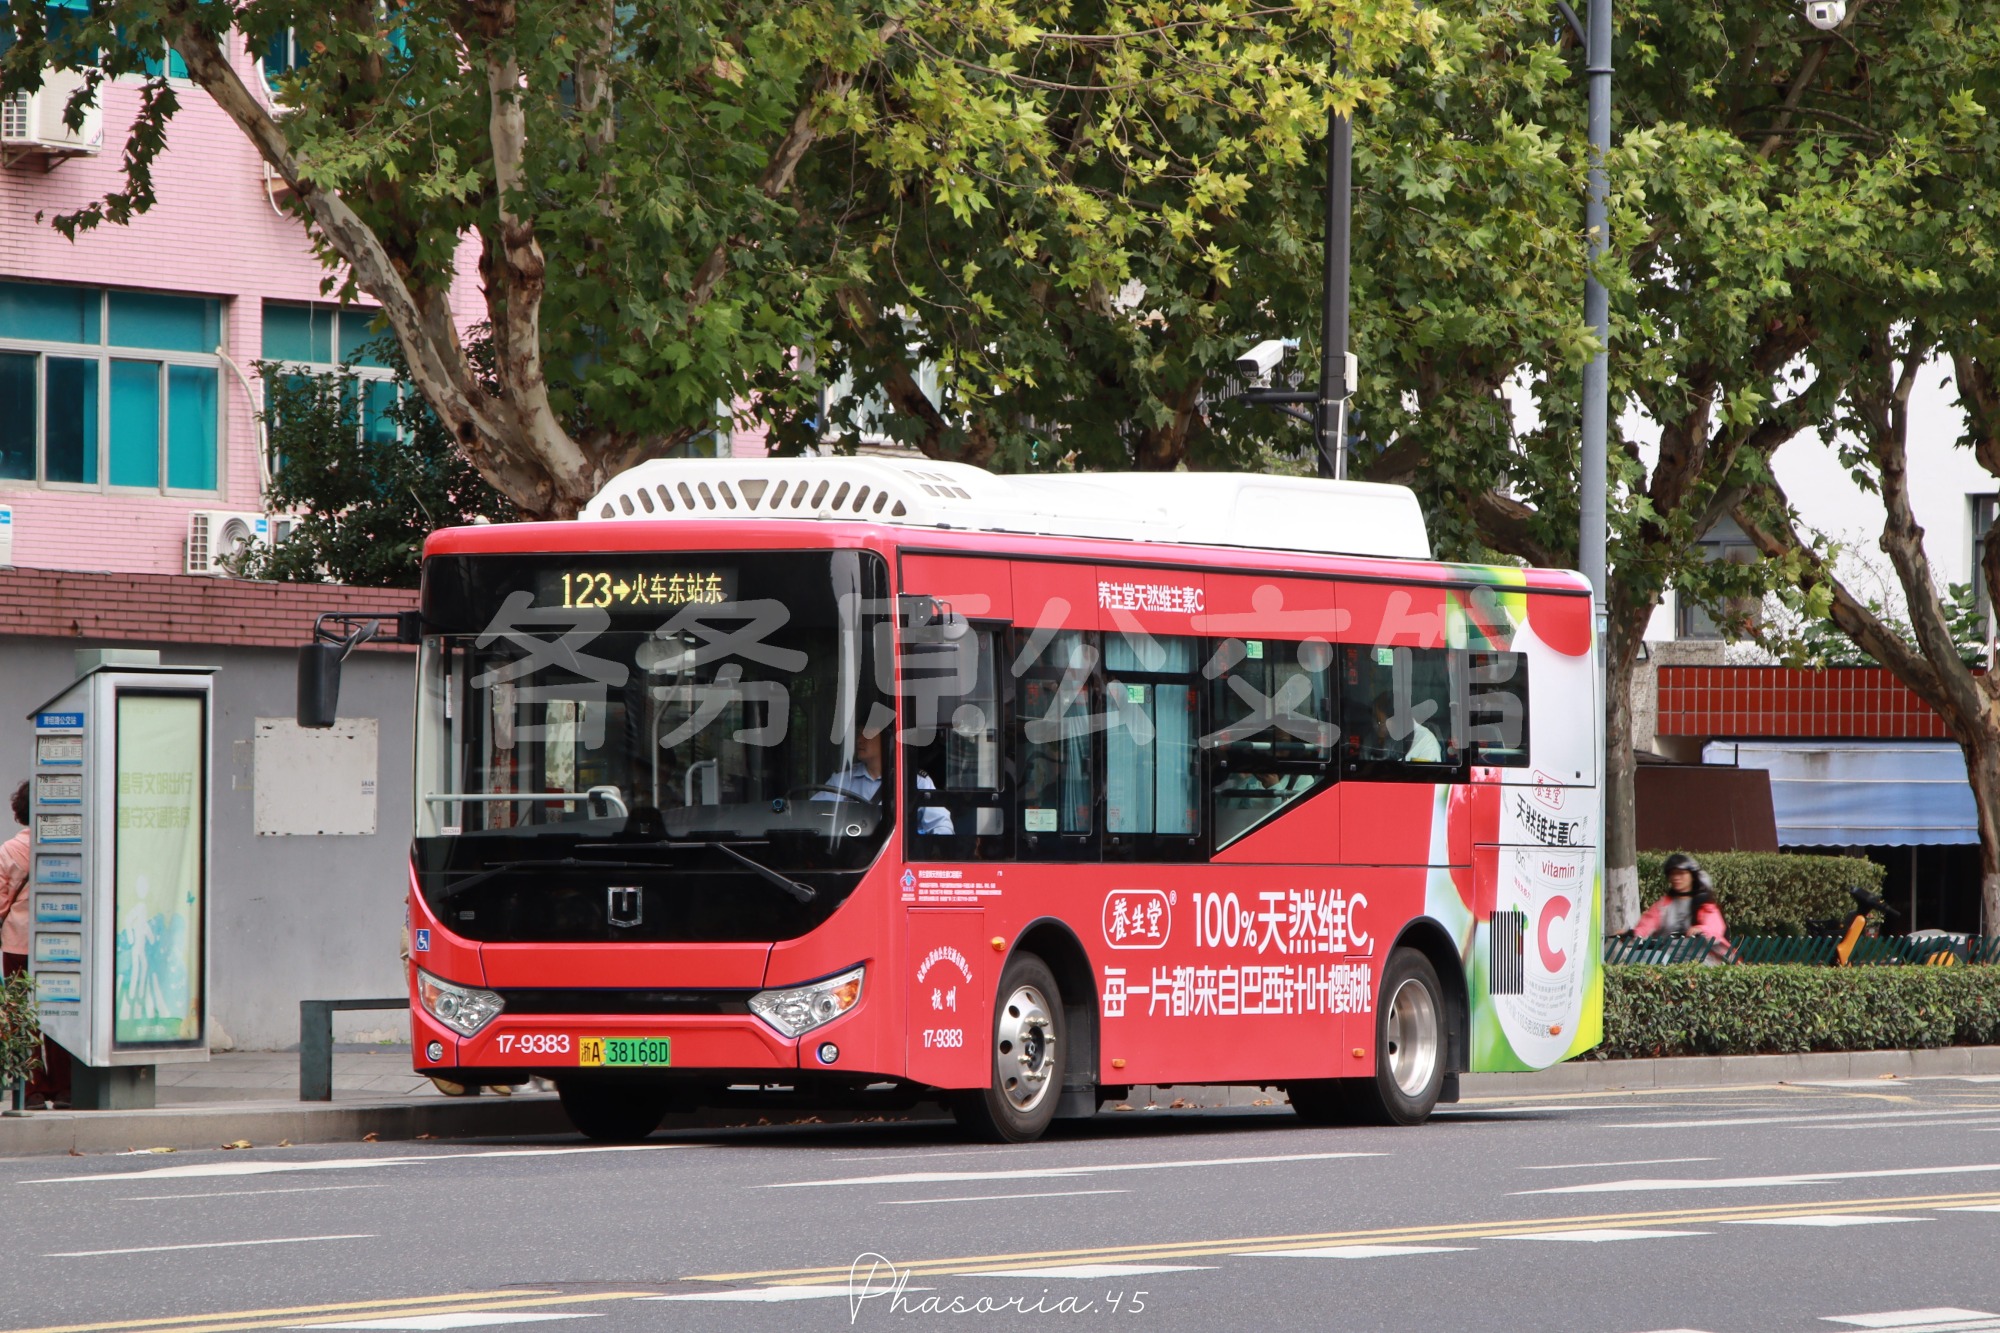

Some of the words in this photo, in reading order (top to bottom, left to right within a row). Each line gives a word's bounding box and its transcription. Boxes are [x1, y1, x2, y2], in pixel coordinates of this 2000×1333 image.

[561, 572, 613, 609] 123
[630, 572, 724, 605] 火车东站东
[1097, 581, 1205, 614] 养生堂天然维生素C
[1541, 860, 1575, 879] vitamin
[1537, 895, 1572, 974] C
[931, 985, 957, 1013] 杭州
[1102, 964, 1372, 1018] 每一片都来自巴西针叶樱桃
[495, 1034, 570, 1053] 17-9383
[922, 1028, 963, 1048] 17-9383
